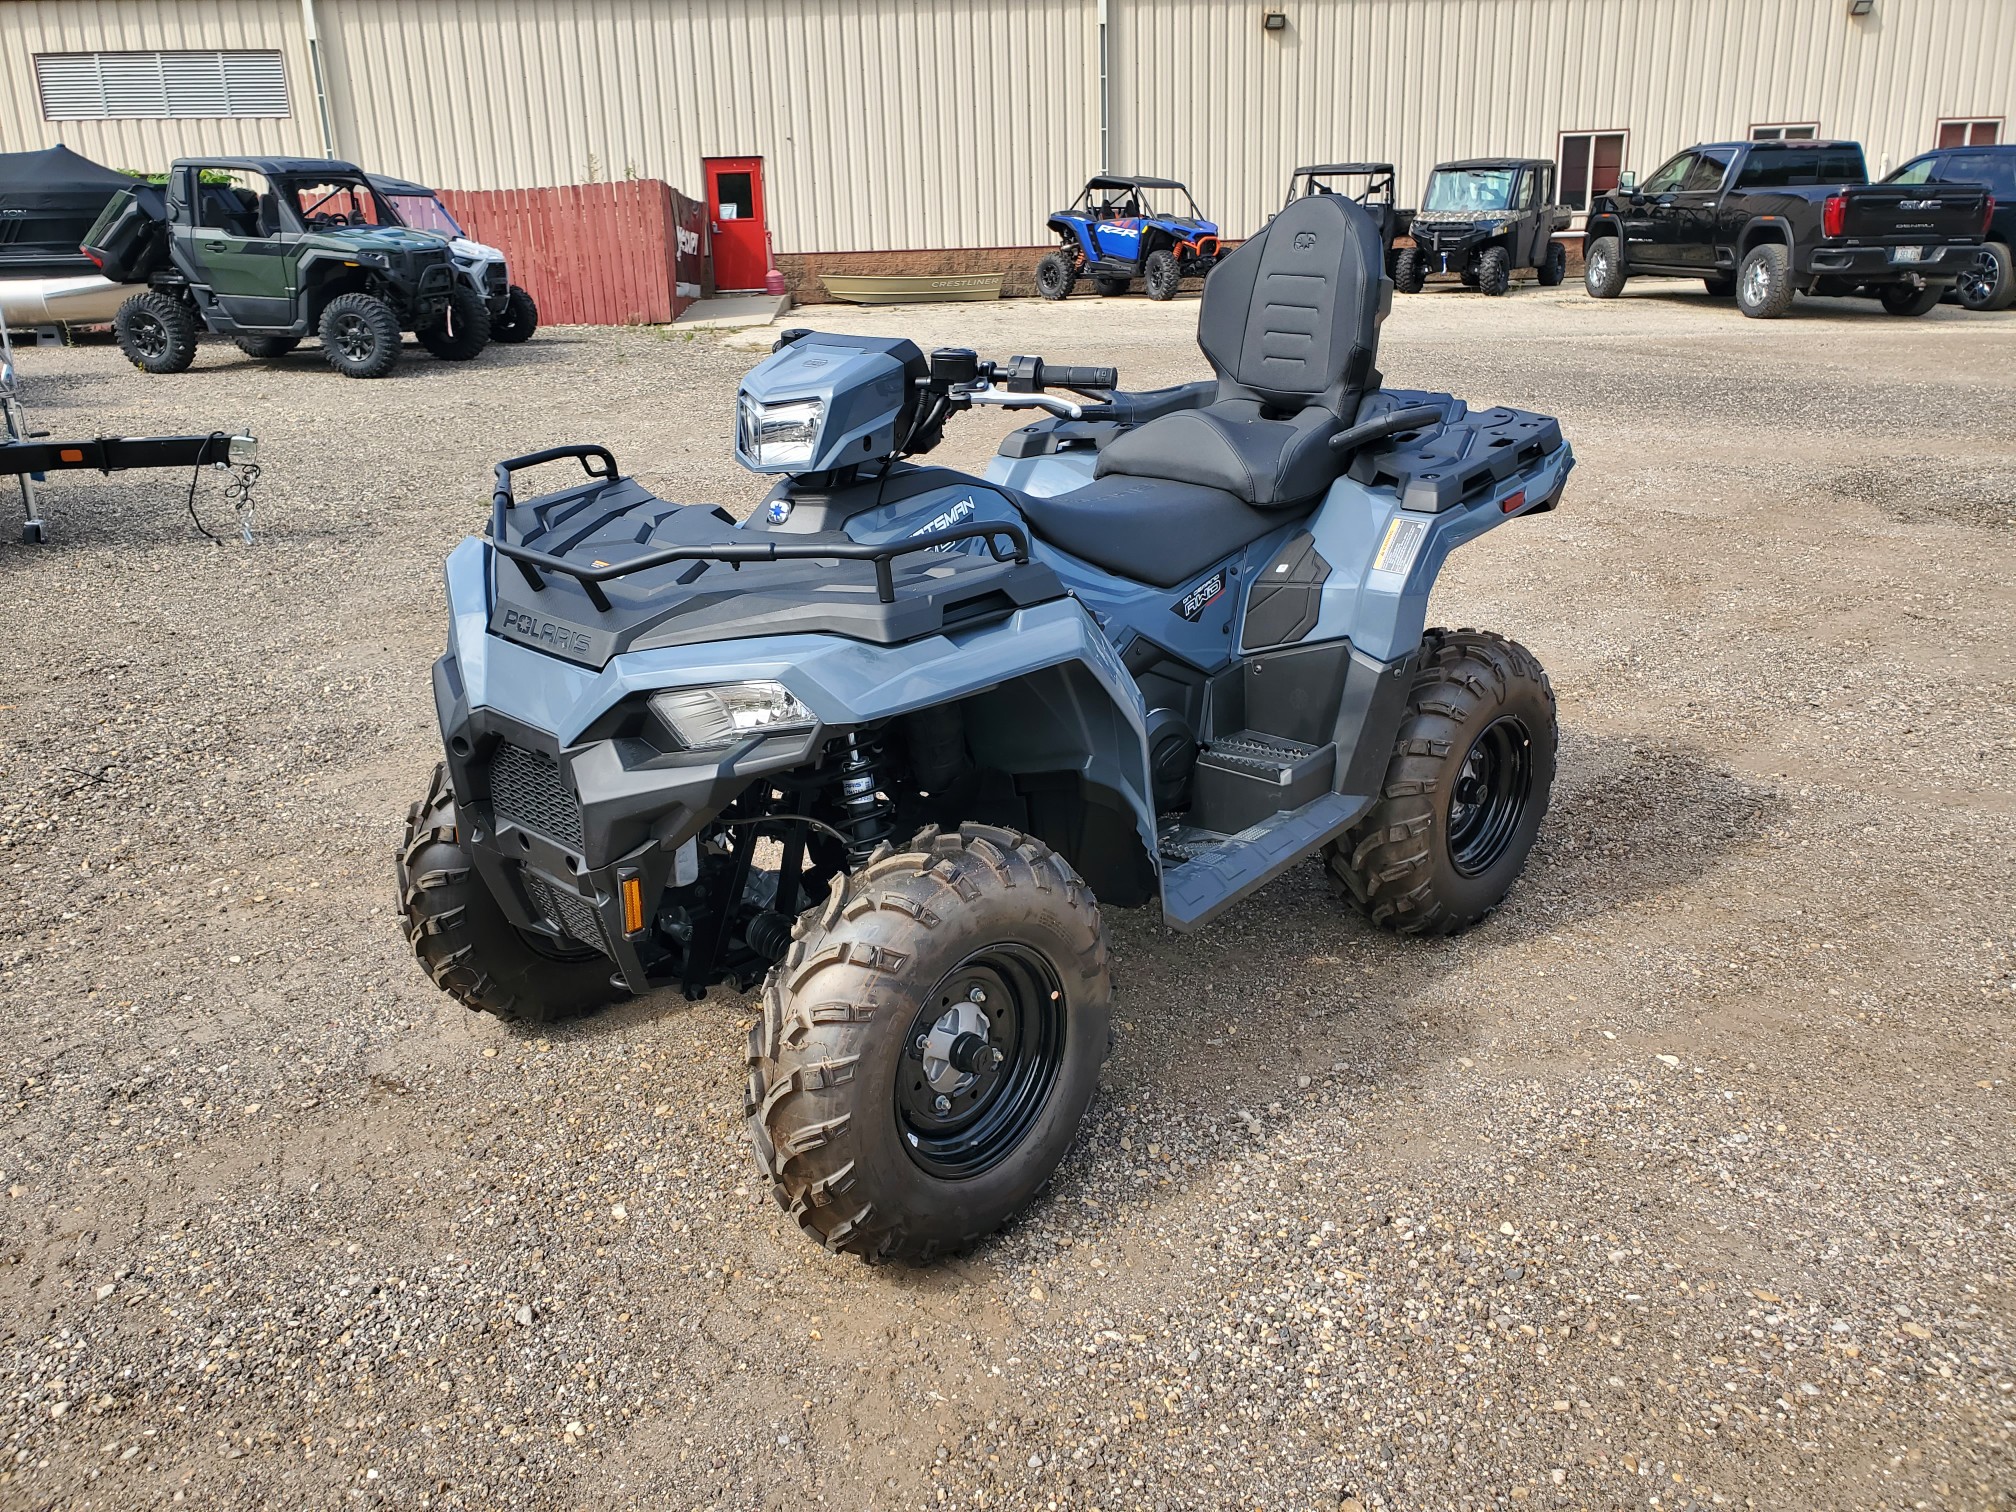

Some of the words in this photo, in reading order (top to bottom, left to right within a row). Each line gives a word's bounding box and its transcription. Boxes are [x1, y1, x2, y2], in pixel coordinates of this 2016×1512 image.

[1900, 200, 1942, 210] GMC
[1097, 224, 1138, 238] RZR
[931, 278, 999, 288] CRESTLINER
[1184, 579, 1221, 617] AWD
[503, 609, 592, 655] POLARIS
